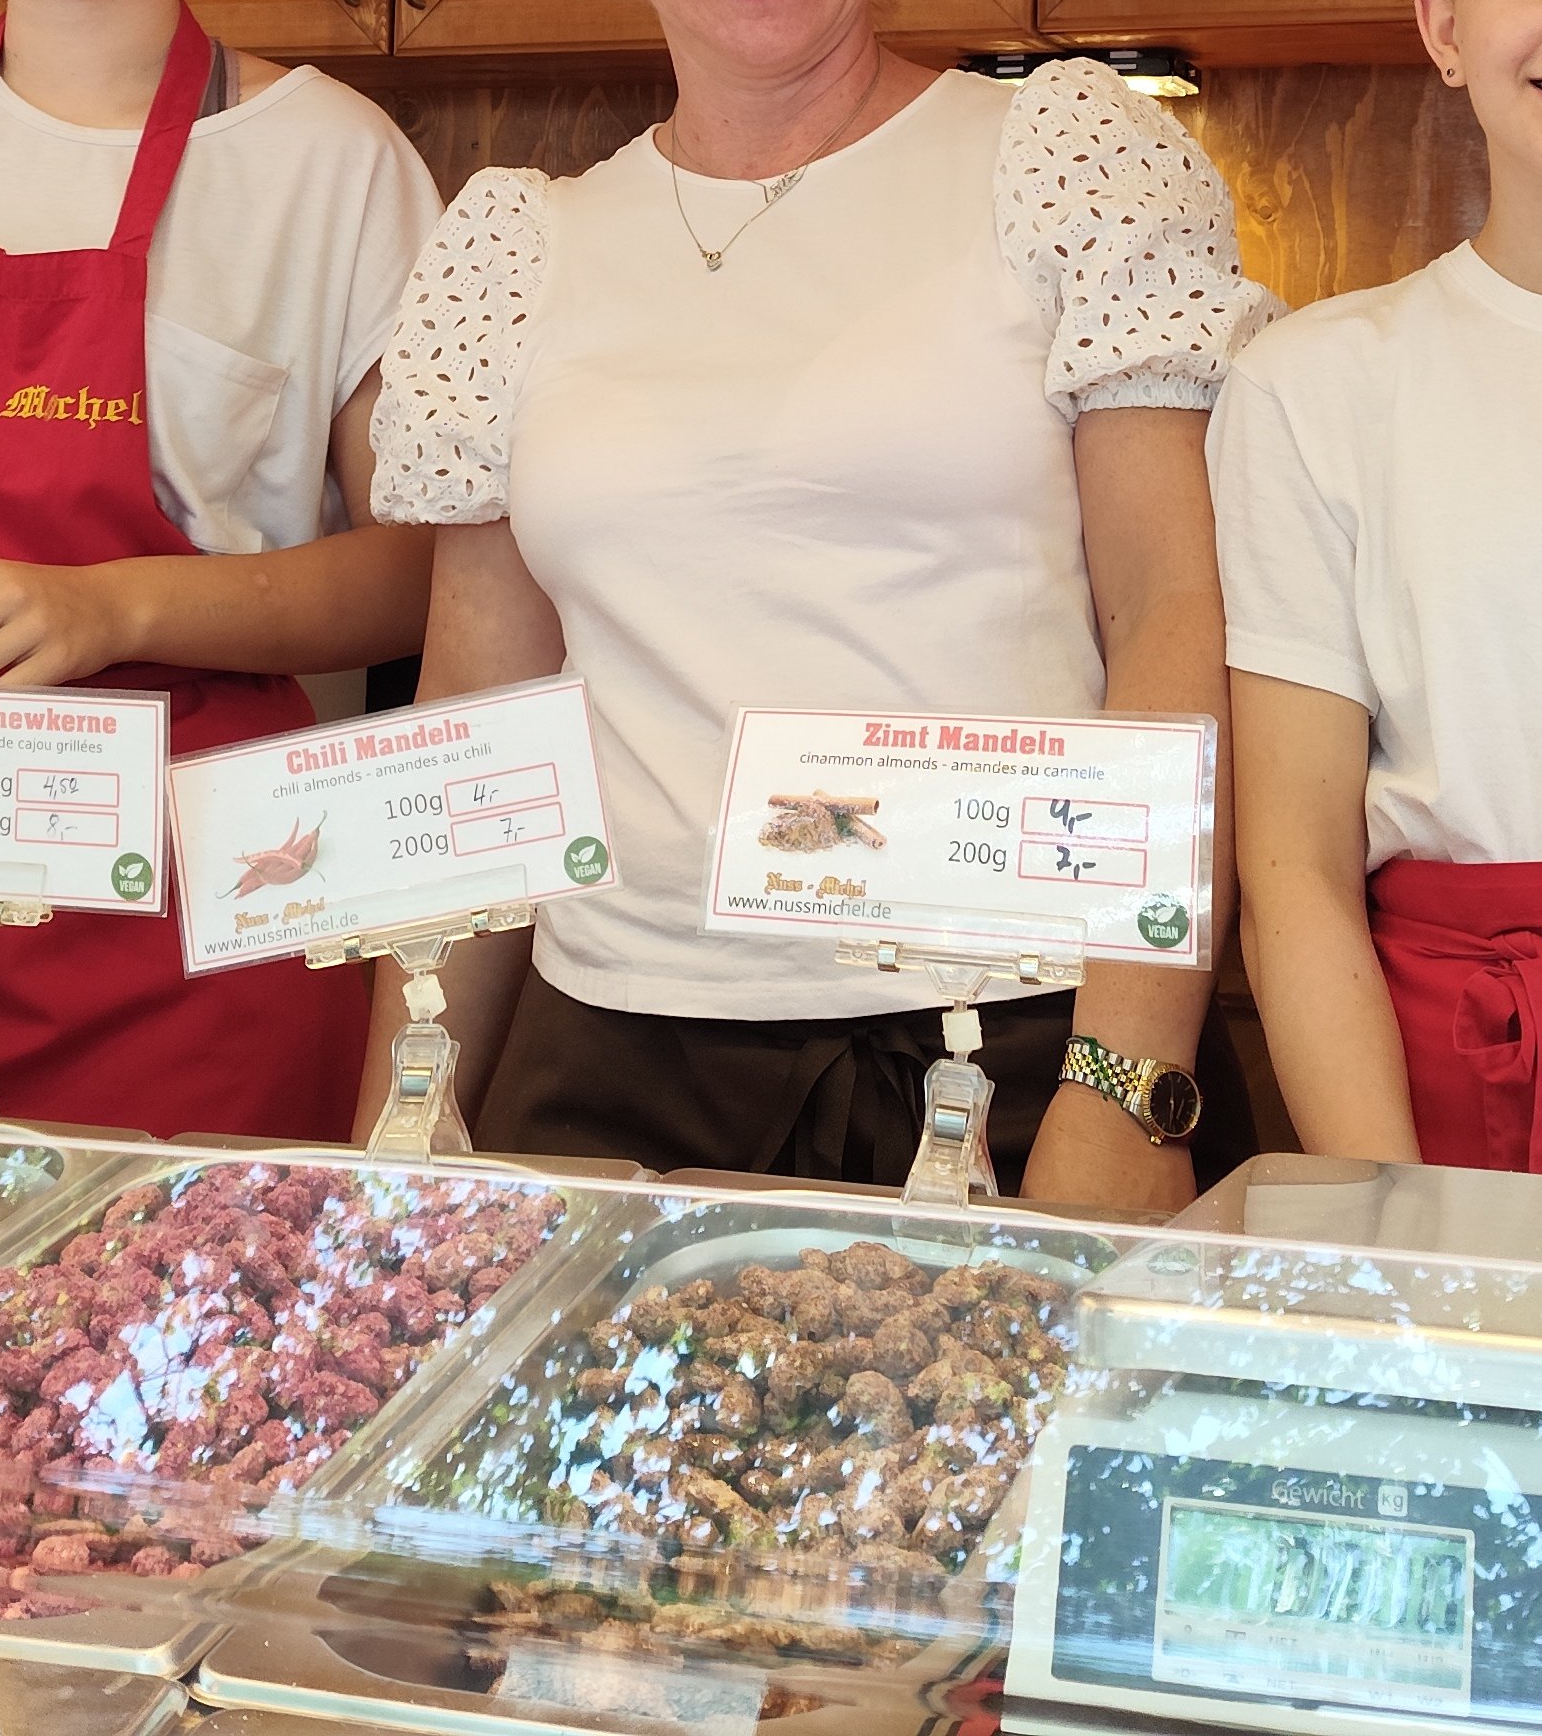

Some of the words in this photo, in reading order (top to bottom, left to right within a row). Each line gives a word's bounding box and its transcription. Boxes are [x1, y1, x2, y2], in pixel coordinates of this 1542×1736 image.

[17, 737, 52, 754] cajou
[56, 738, 103, 755] grillées
[286, 741, 348, 775] Chili
[354, 719, 471, 762] Mandeln
[862, 722, 930, 749] Zimt
[937, 726, 1066, 757] Mandeln
[272, 781, 300, 799] chili
[304, 770, 363, 793] almonds
[375, 754, 439, 778] amandes
[442, 751, 460, 764] au
[464, 742, 493, 760] chili
[799, 751, 874, 768] cinammon
[877, 754, 939, 770] almonds
[951, 759, 1017, 776] amandes
[1021, 764, 1039, 777] au
[1044, 764, 1105, 781] cannelle
[384, 793, 444, 820] 100g
[954, 798, 1011, 829] 100g
[389, 832, 449, 860] 200g
[948, 840, 1007, 873] 200g
[573, 862, 602, 878] VEGAN
[764, 871, 803, 896] Nuss
[119, 879, 145, 895] VEGAN
[727, 895, 892, 920] www.nussmichel.de
[204, 912, 360, 955] www.nussmichel.de
[1148, 923, 1179, 940] VEGAN
[1271, 1478, 1363, 1510] Gewicht
[1382, 1492, 1405, 1512] kg
